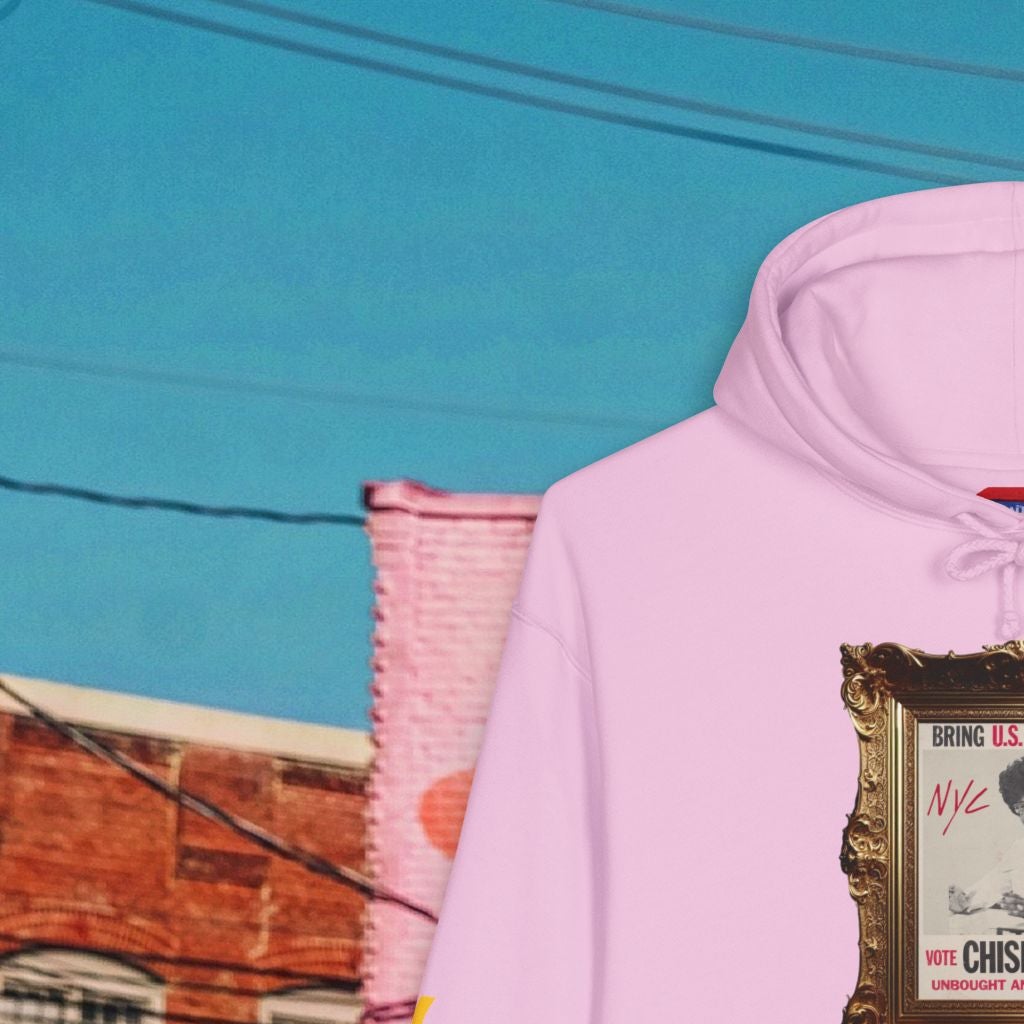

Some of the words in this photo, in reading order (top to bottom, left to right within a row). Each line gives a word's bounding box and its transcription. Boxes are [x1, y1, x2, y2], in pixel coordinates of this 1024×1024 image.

[932, 725, 985, 747] BRING
[992, 724, 1023, 747] U.S.
[927, 779, 990, 836] NYC
[926, 949, 957, 966] VOTE
[931, 979, 1006, 991] UNBOUGHT
